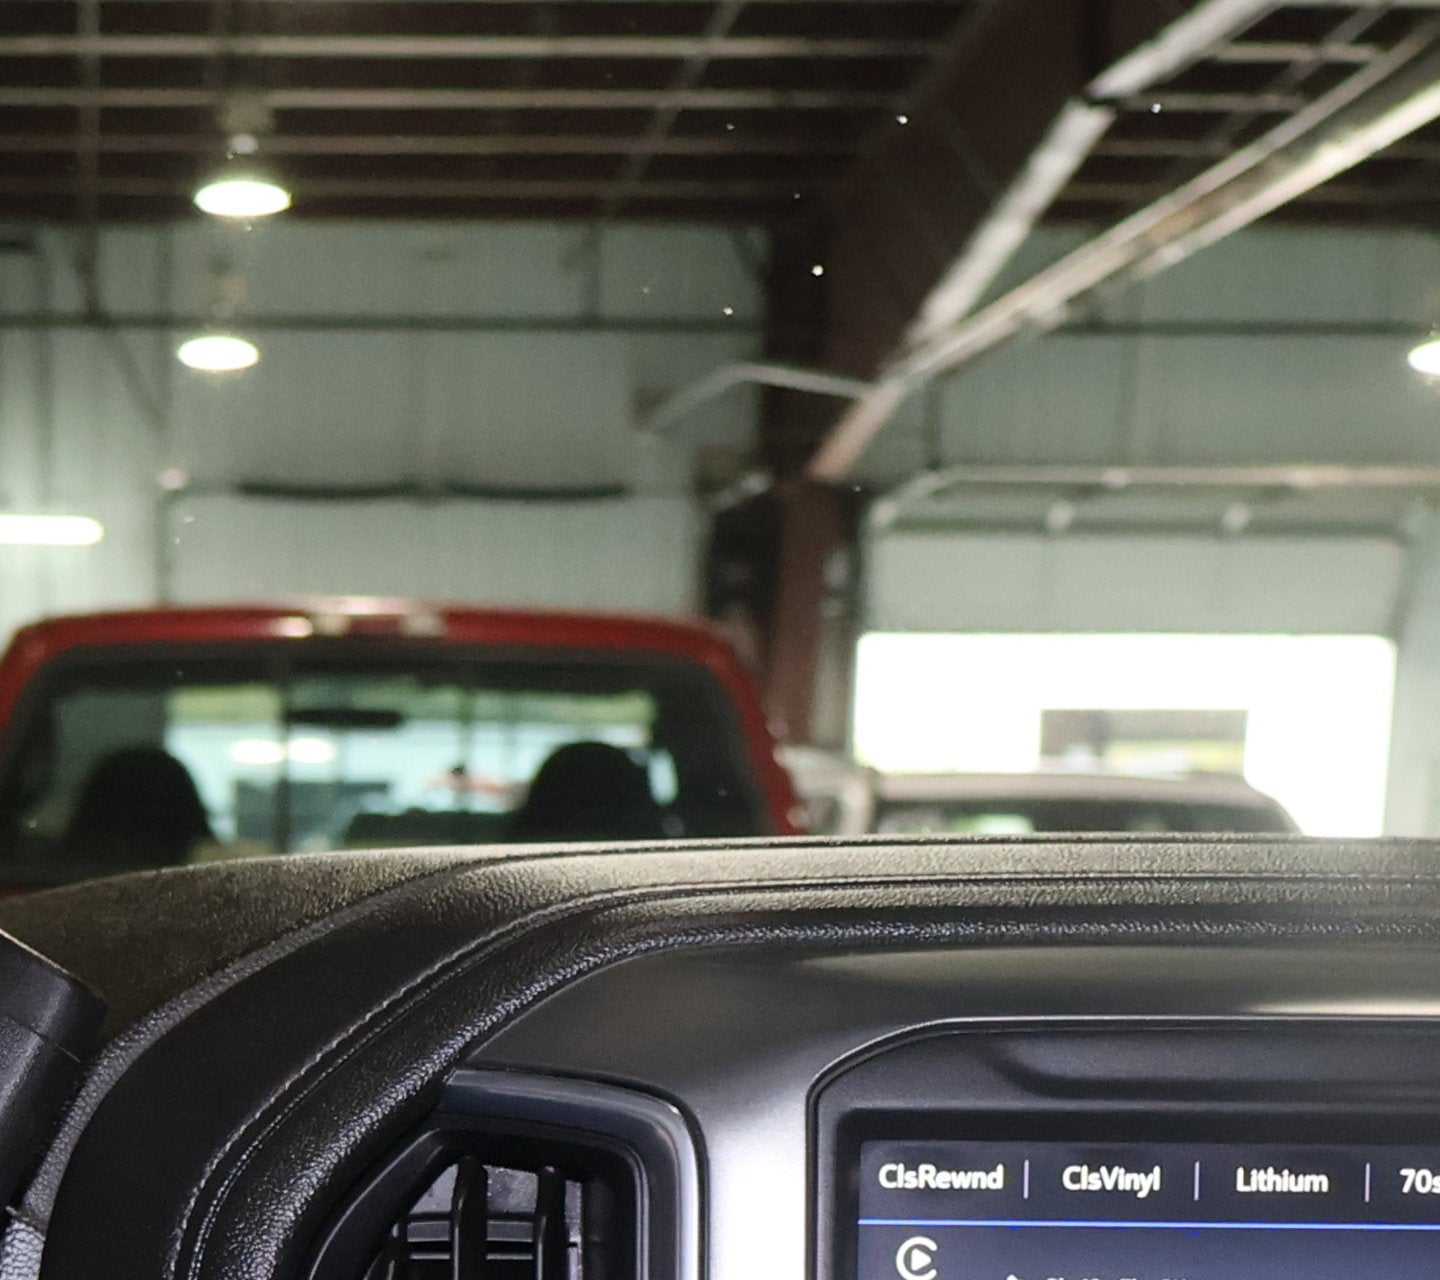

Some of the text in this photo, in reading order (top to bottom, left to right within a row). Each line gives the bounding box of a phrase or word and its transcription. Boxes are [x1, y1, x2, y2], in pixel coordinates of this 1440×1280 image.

[879, 1163, 1004, 1190] ClsRewnd
[1062, 1164, 1161, 1198] ClsVinyl
[1236, 1166, 1329, 1193] Lithium
